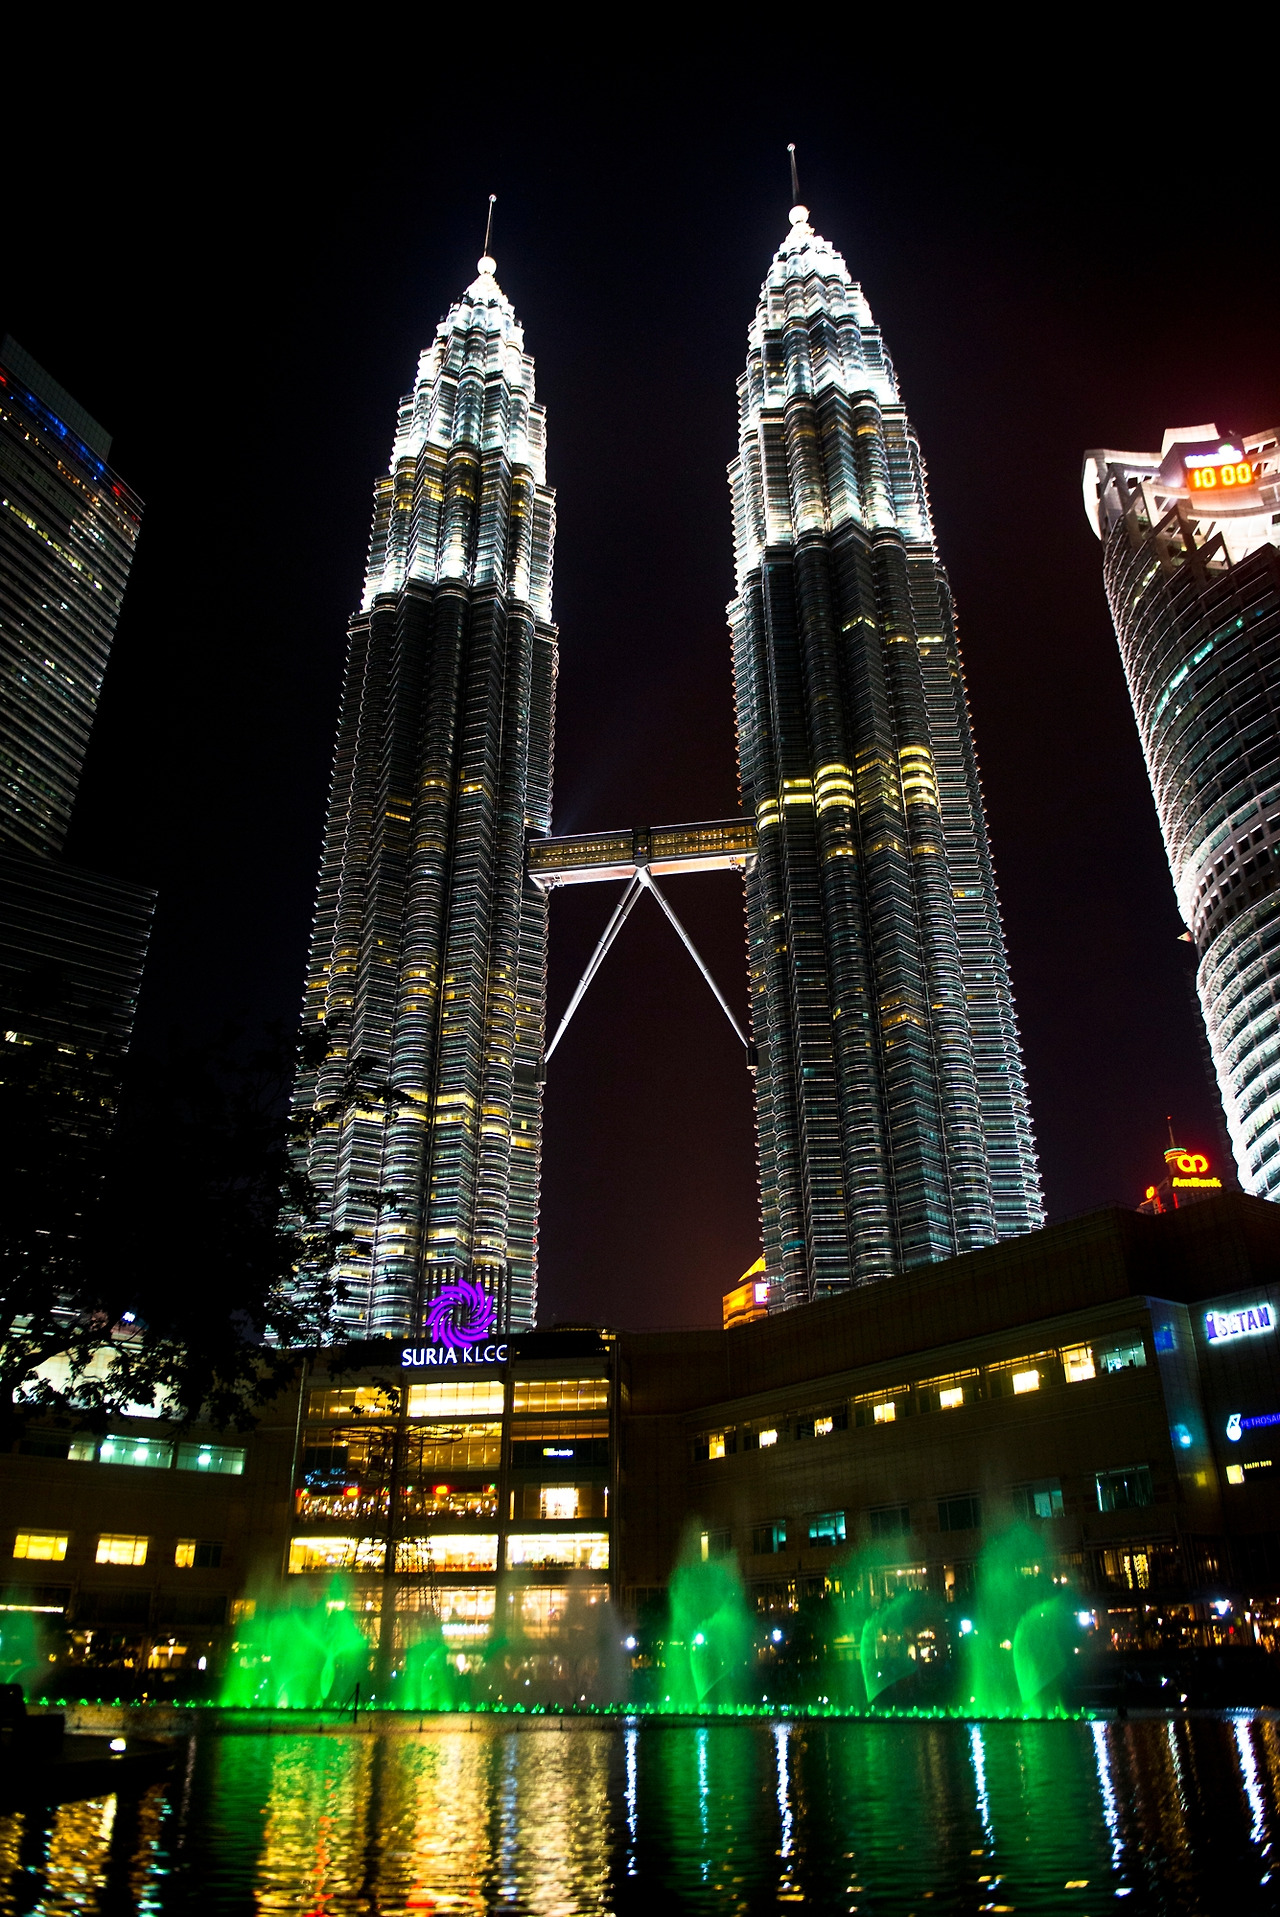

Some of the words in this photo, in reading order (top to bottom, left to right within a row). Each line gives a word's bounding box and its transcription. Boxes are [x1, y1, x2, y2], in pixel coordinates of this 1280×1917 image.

[1172, 1176, 1222, 1188] AmBank
[401, 1346, 458, 1367] SURIA
[463, 1344, 508, 1363] KLCC
